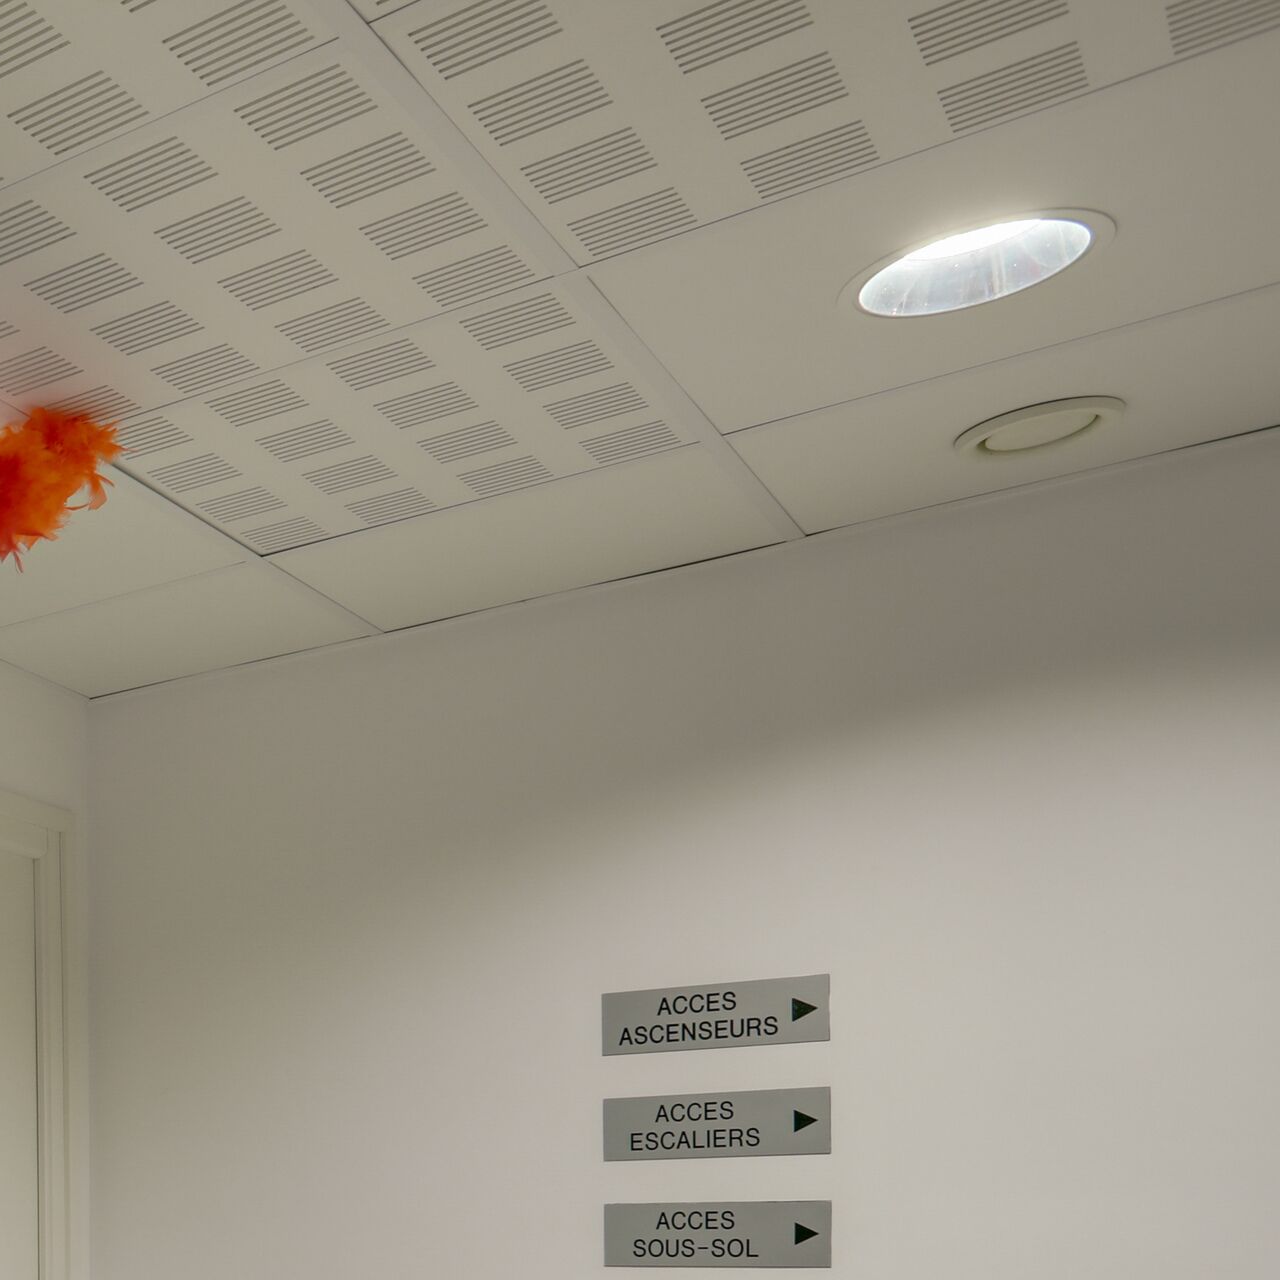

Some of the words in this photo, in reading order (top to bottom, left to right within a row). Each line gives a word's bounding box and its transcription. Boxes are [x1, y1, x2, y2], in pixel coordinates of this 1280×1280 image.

[657, 991, 737, 1016] ACCES
[619, 1016, 779, 1046] ASCENSEURS
[655, 1101, 734, 1123] ACCES
[630, 1127, 760, 1151] ESCALIERS
[655, 1211, 735, 1231] ACCES
[633, 1238, 759, 1258] SOUS-SOL
